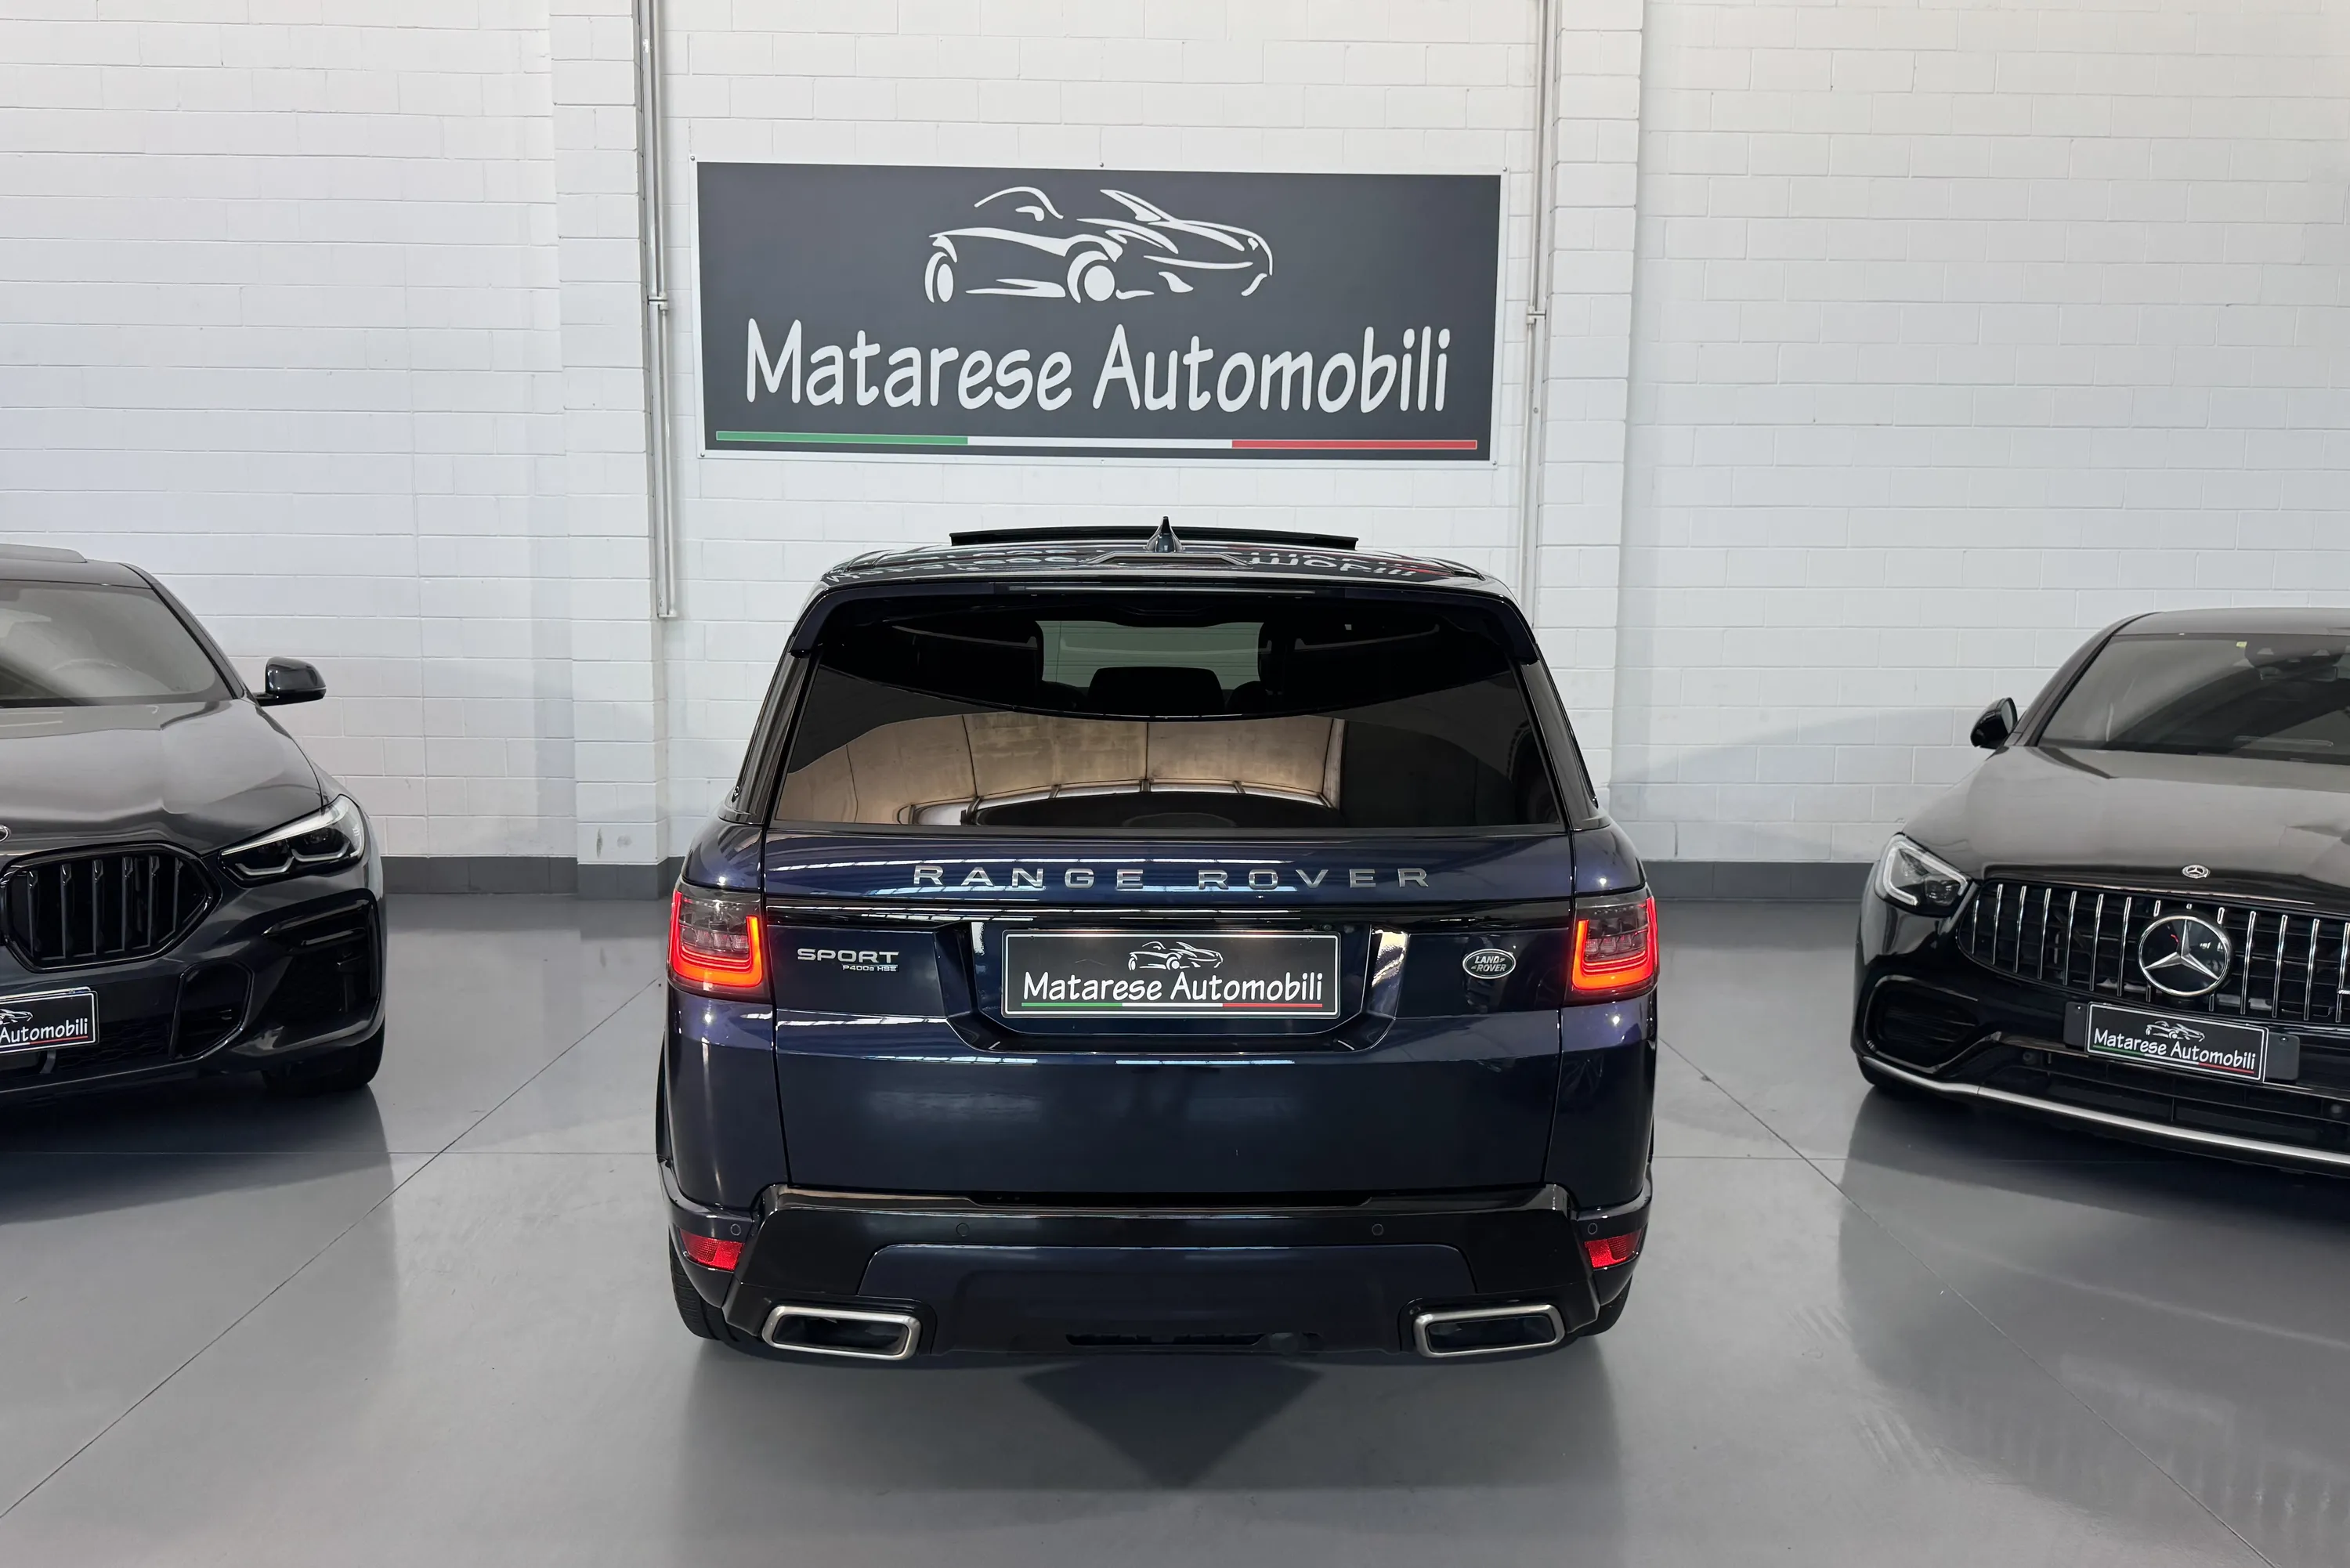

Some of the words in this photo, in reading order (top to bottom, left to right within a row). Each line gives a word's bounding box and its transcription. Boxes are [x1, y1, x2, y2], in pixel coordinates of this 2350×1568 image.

[746, 318, 1072, 412] Matarese
[1091, 323, 1452, 414] Automobili
[913, 865, 1145, 890] RANGE
[1197, 867, 1430, 890] ROVER
[797, 948, 899, 963] SPORT
[1474, 956, 1500, 964] LAND
[1476, 963, 1507, 972] ROVER
[1022, 970, 1163, 1001] Matarese
[1170, 971, 1323, 1001] Automobili
[0, 1017, 89, 1043] Automobili
[2093, 1028, 2167, 1056] Matarese
[2170, 1041, 2256, 1071] Automobili
